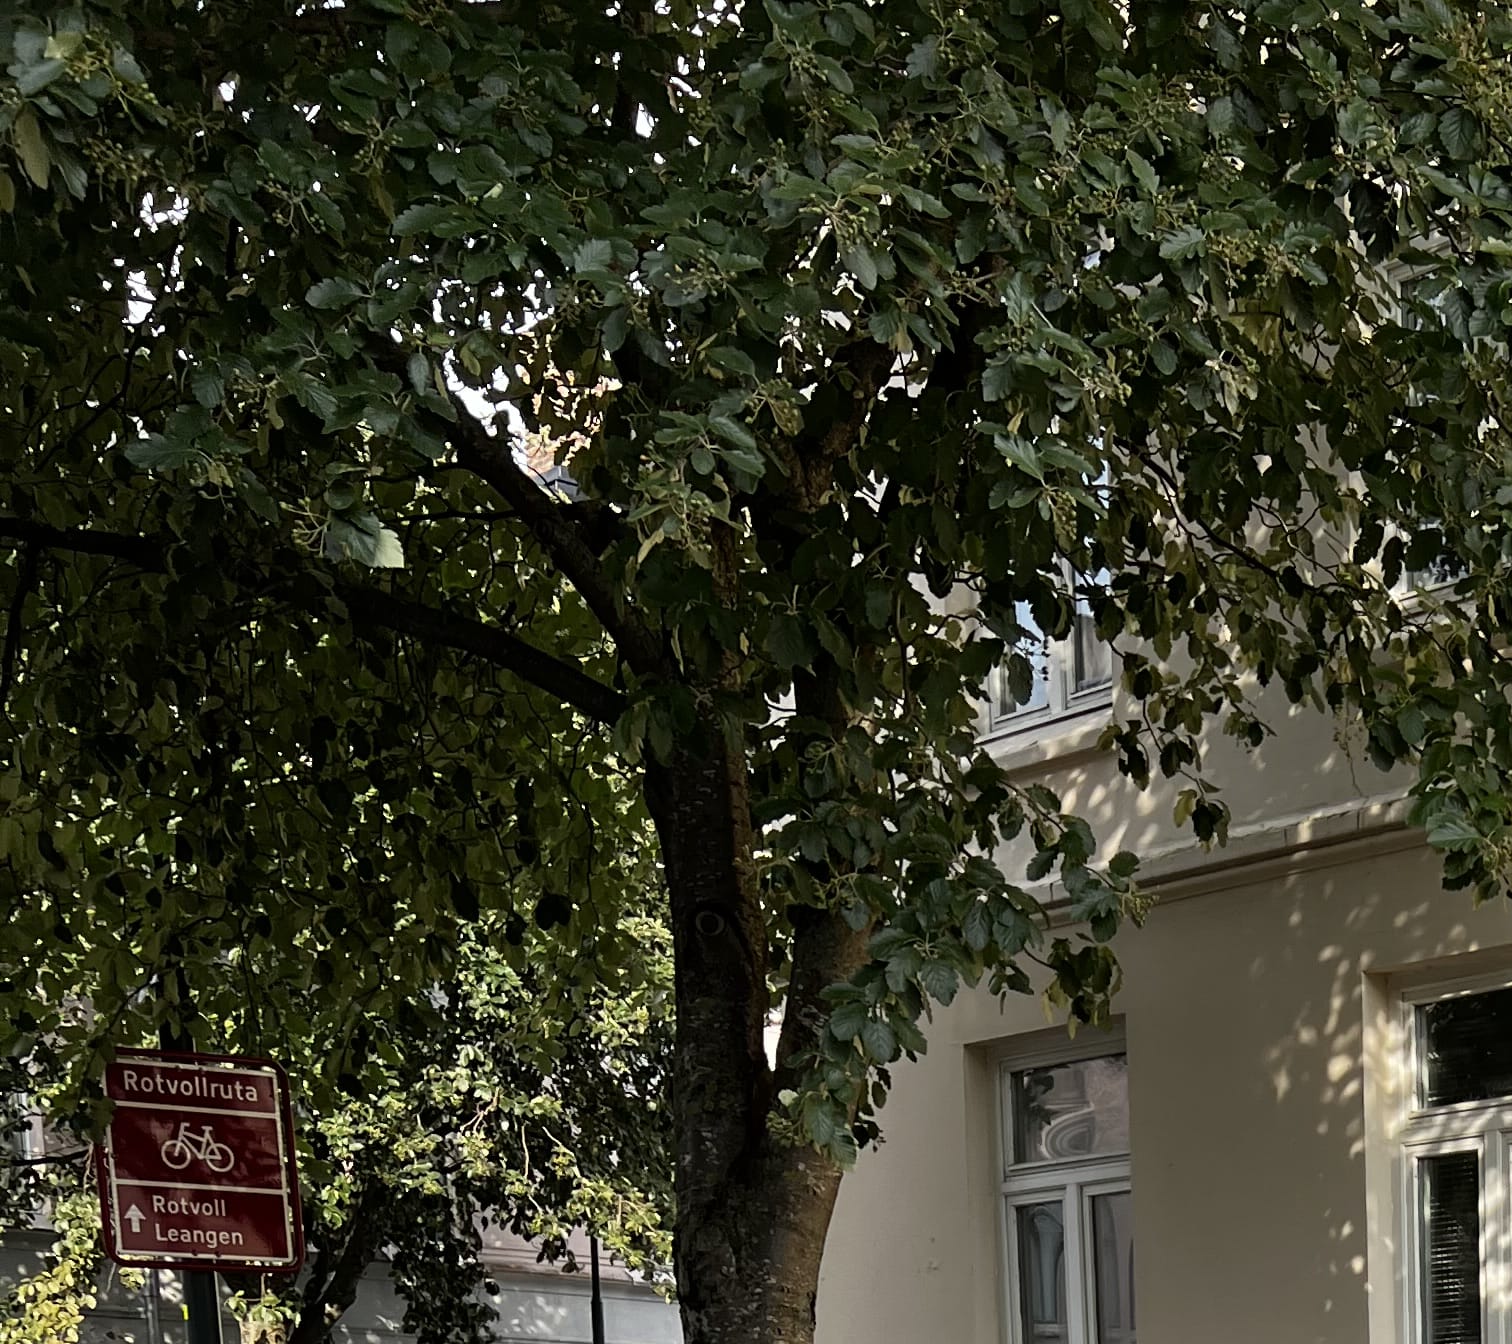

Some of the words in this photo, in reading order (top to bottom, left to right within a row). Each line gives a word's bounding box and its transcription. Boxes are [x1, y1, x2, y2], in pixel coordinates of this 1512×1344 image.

[123, 1069, 258, 1102] Rotvollruta
[152, 1194, 226, 1217] Rotvoll
[154, 1223, 244, 1249] Leangen
